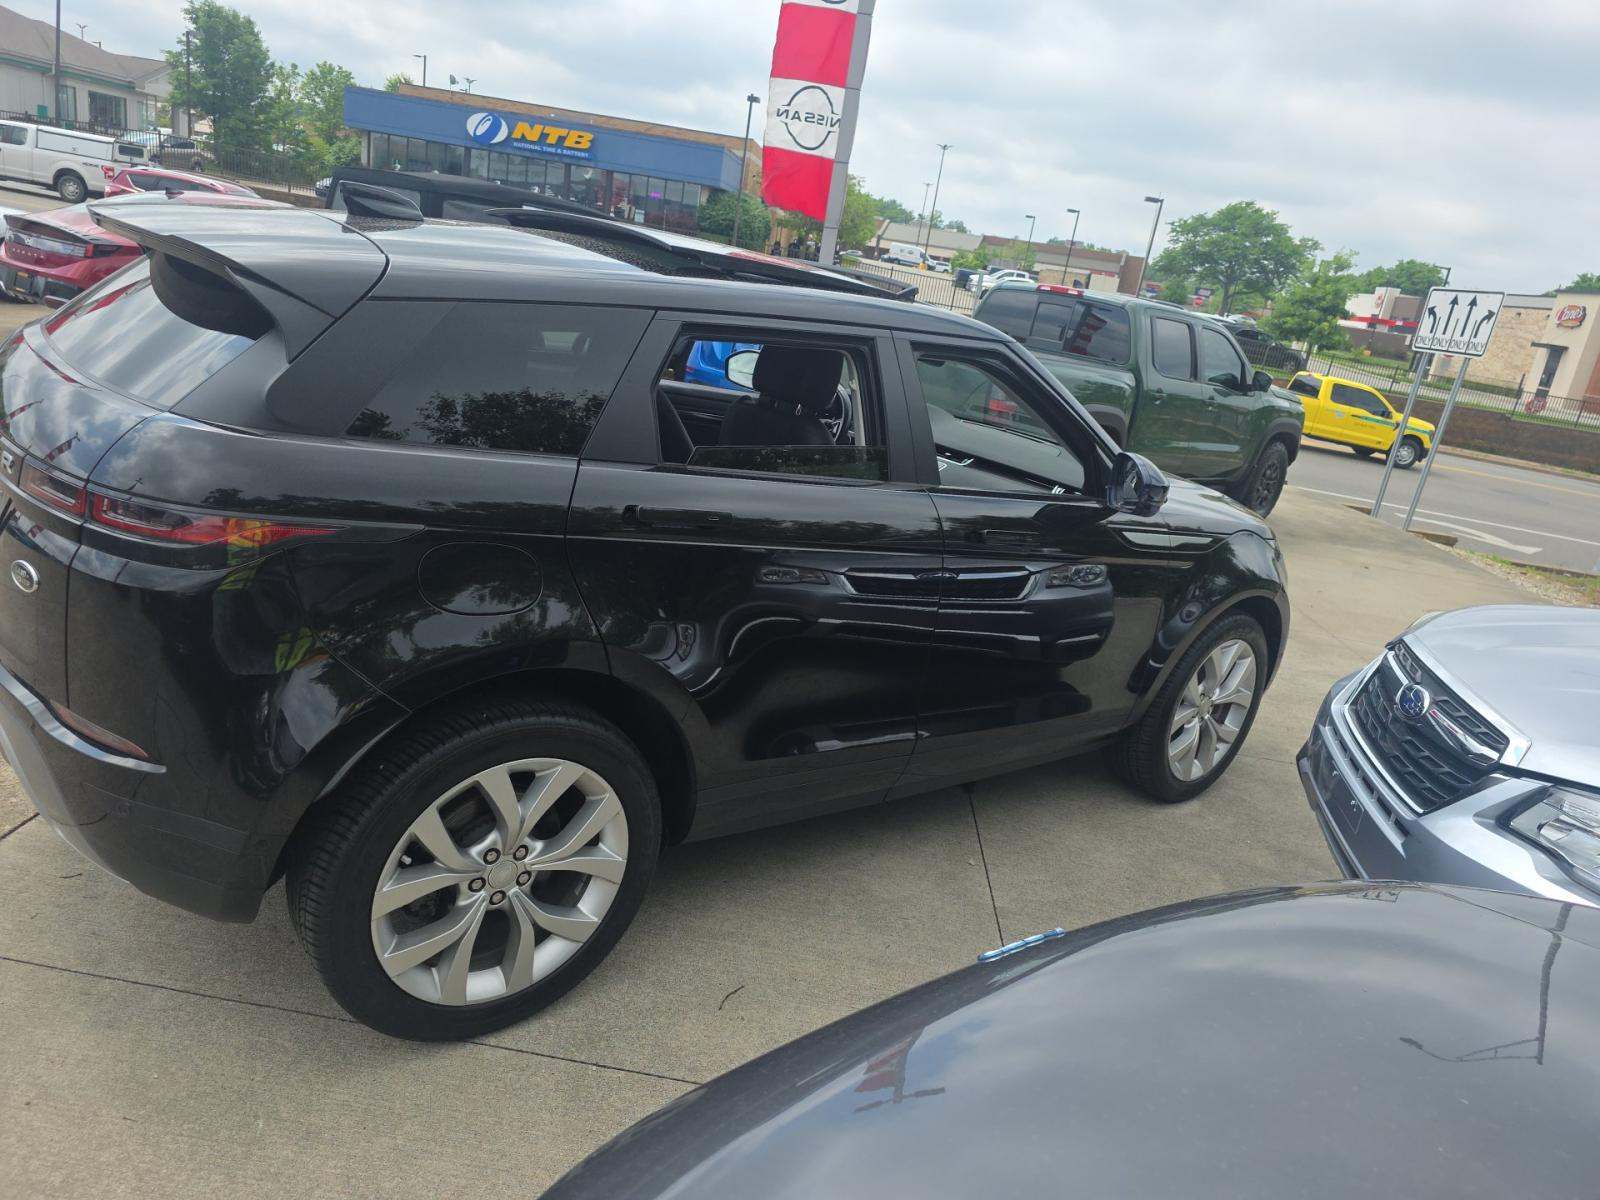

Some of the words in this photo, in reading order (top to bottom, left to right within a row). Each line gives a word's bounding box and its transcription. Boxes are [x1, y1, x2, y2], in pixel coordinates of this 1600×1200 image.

[512, 121, 593, 149] NTB
[513, 141, 541, 151] NATIONAL
[563, 149, 589, 158] BATTERY
[1416, 335, 1432, 346] ONLY
[1433, 337, 1450, 348] ONLY
[1450, 339, 1468, 350] ONLY
[1468, 341, 1485, 353] ONLY
